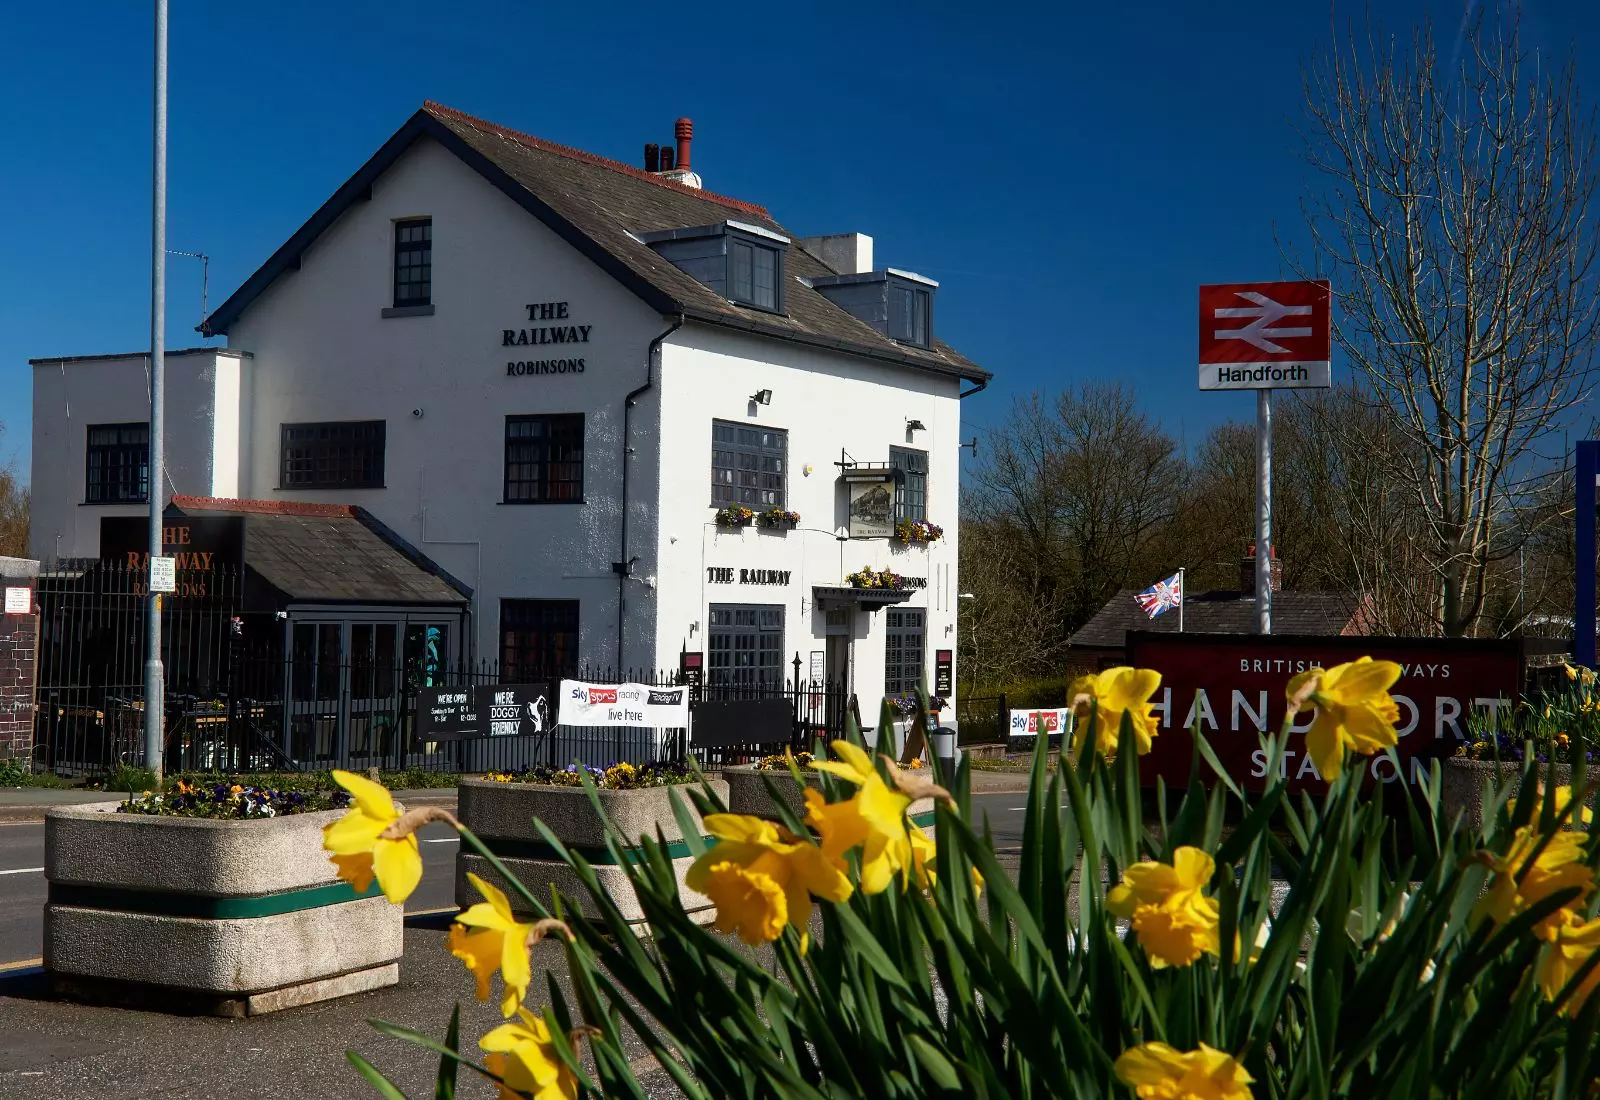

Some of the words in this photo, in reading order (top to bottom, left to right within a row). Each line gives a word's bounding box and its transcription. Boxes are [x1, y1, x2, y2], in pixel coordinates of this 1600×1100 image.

[526, 302, 569, 320] THE
[502, 325, 592, 346] RAILWAY
[507, 358, 586, 376] ROBINSONS
[1218, 365, 1308, 382] Handforth
[162, 527, 191, 545] HE
[127, 552, 214, 570] RAWAY
[706, 567, 735, 584] THE
[739, 569, 792, 587] RAILWAY
[1240, 659, 1322, 674] BRITISH
[453, 693, 467, 704] OPEN
[572, 687, 588, 702] sky
[618, 691, 640, 701] racing
[491, 707, 520, 718] DOGGY
[608, 708, 622, 721] live
[624, 708, 643, 721] here
[491, 721, 521, 736] FRIENDLY
[1012, 714, 1028, 731] sky
[1250, 749, 1436, 785] STAON
